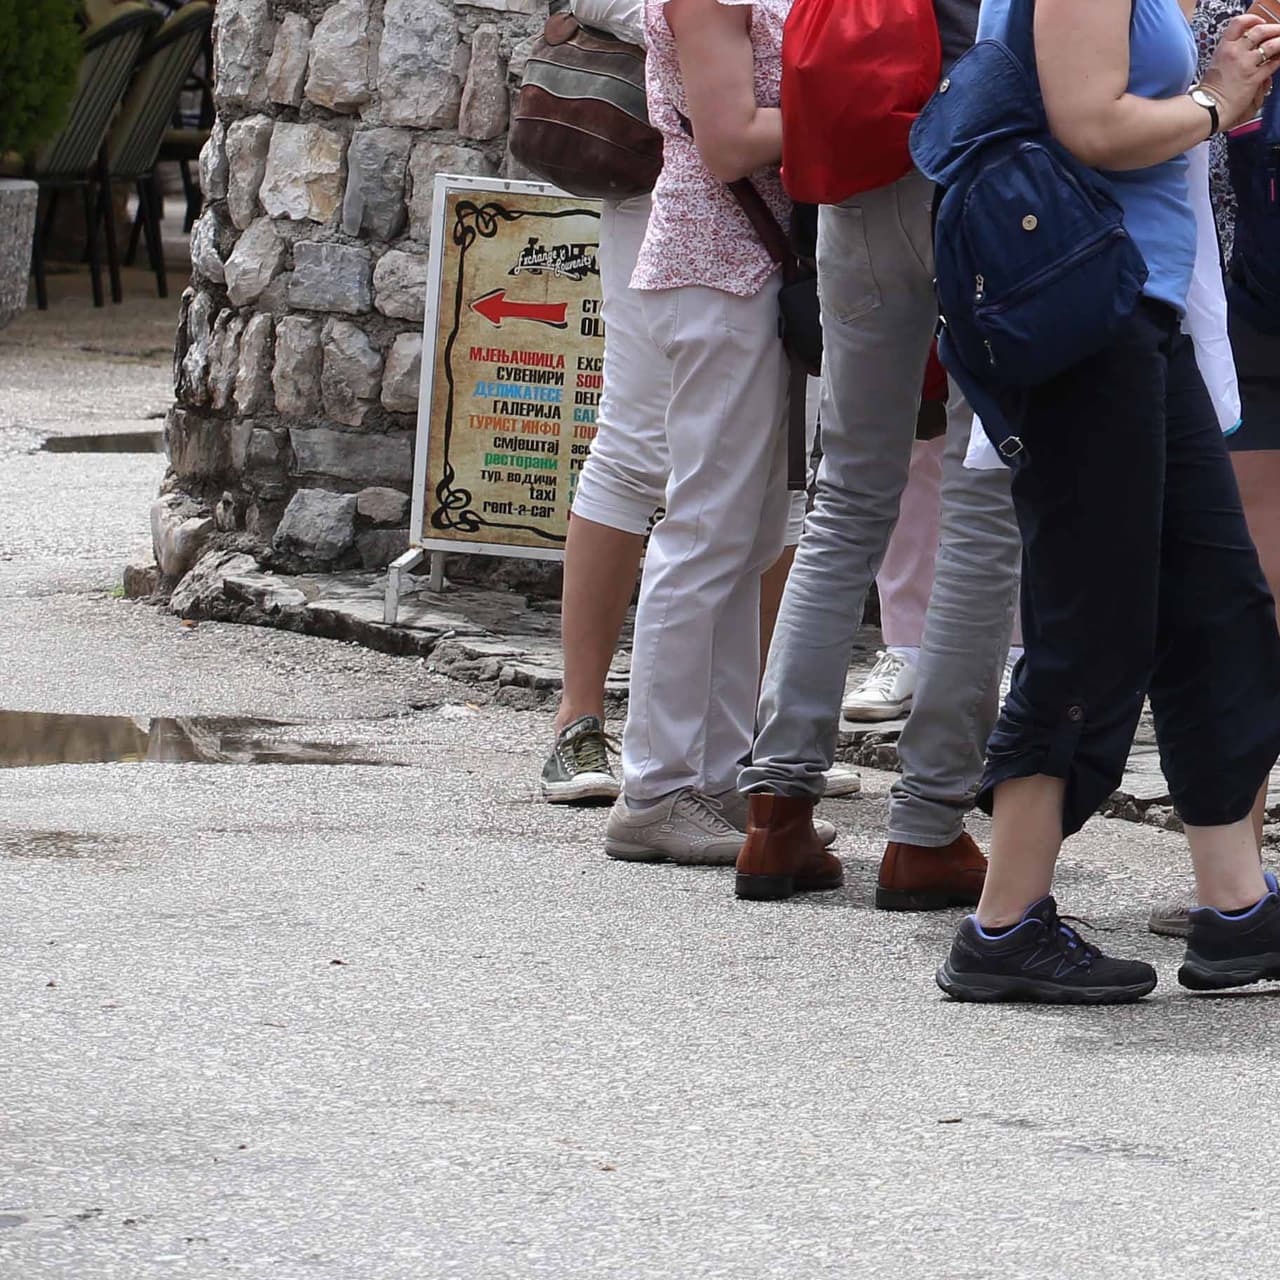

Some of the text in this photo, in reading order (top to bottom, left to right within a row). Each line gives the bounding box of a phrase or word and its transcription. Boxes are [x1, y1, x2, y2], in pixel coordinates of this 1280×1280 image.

[469, 346, 565, 370] МЈЕЊАЧНИЦА
[577, 356, 604, 372] EXC
[496, 366, 564, 386] СУВЕНИРИ
[473, 381, 563, 402] ДЕЛИКАТЕСЕ
[493, 400, 561, 420] ГАЛЕРИЈА
[469, 414, 561, 437] ТУРИСТ ИНФО
[493, 436, 560, 455] смјештај
[484, 452, 558, 470] ресторани
[480, 470, 504, 483] тур.
[530, 485, 556, 501] taxi
[483, 501, 555, 518] rent-a-car
